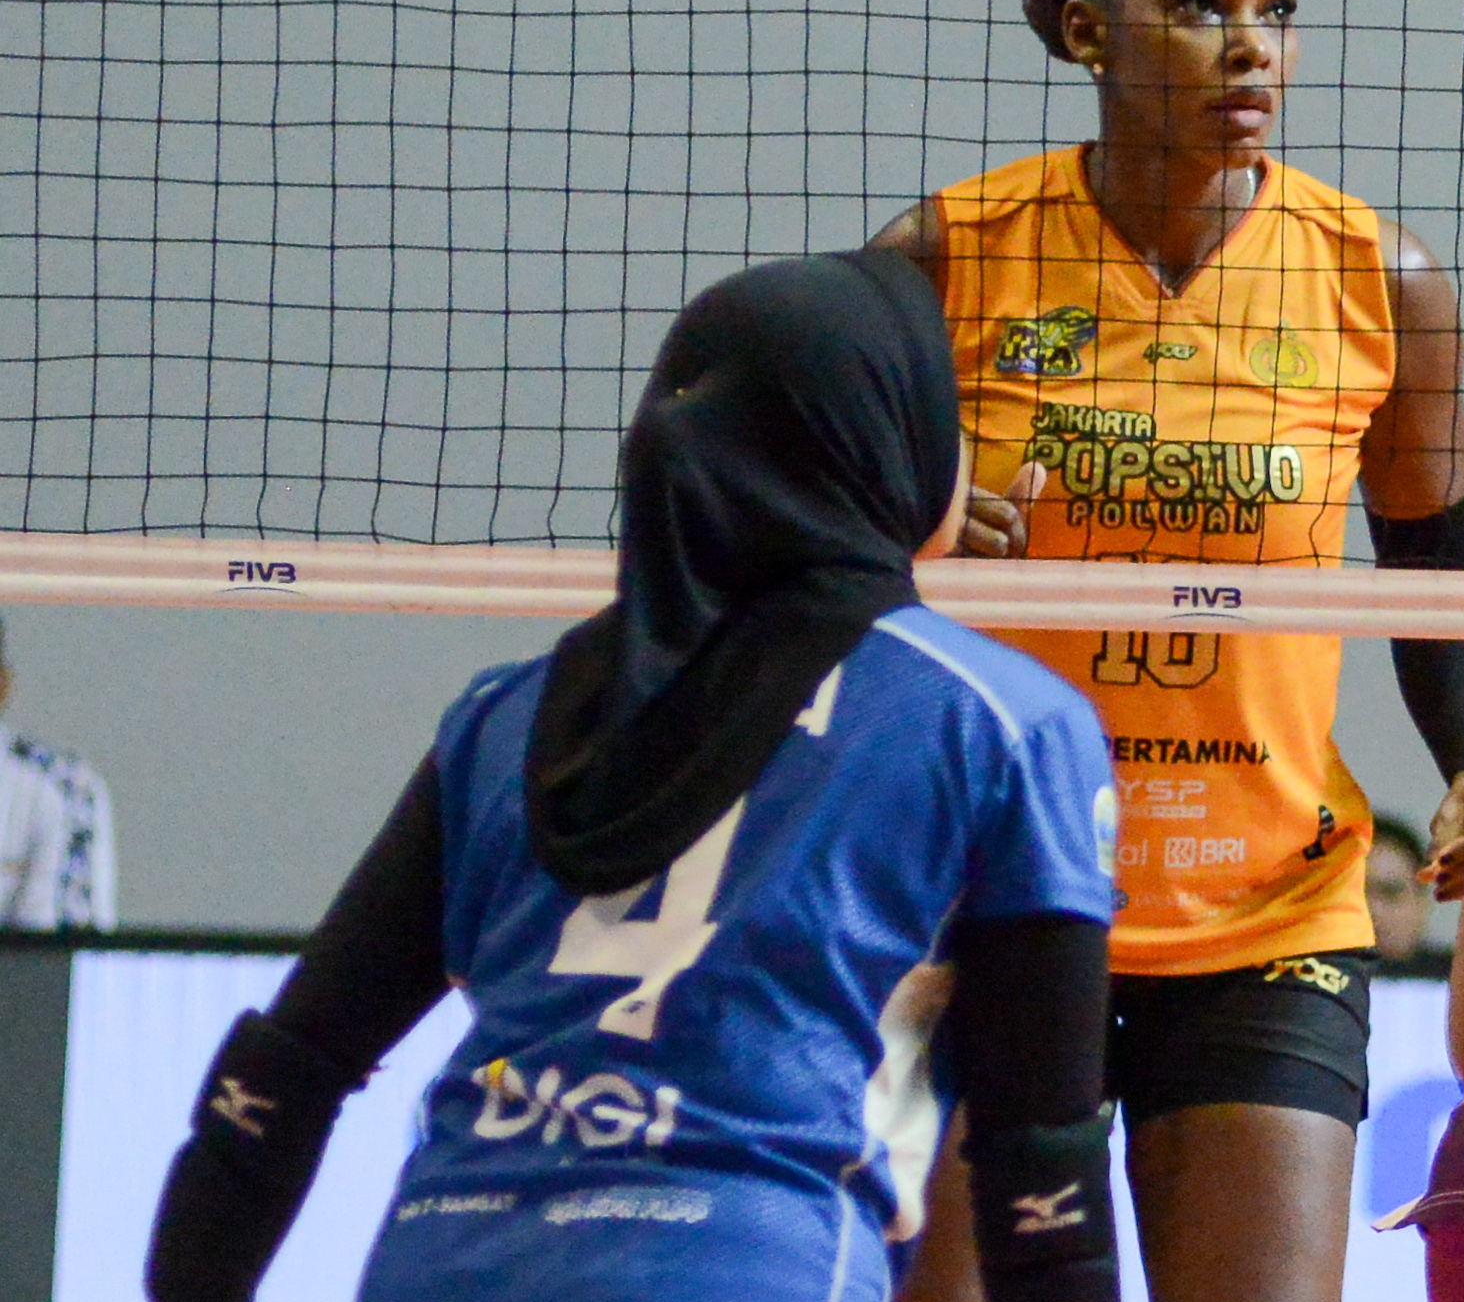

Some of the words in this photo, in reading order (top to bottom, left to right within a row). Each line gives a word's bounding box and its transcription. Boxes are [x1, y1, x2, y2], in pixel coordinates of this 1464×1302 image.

[1031, 402, 1156, 438] JAKARTA
[1067, 497, 1261, 533] POLWAN
[228, 561, 296, 583] FIVB
[1173, 586, 1242, 609] FIVB
[548, 795, 748, 1041] 4
